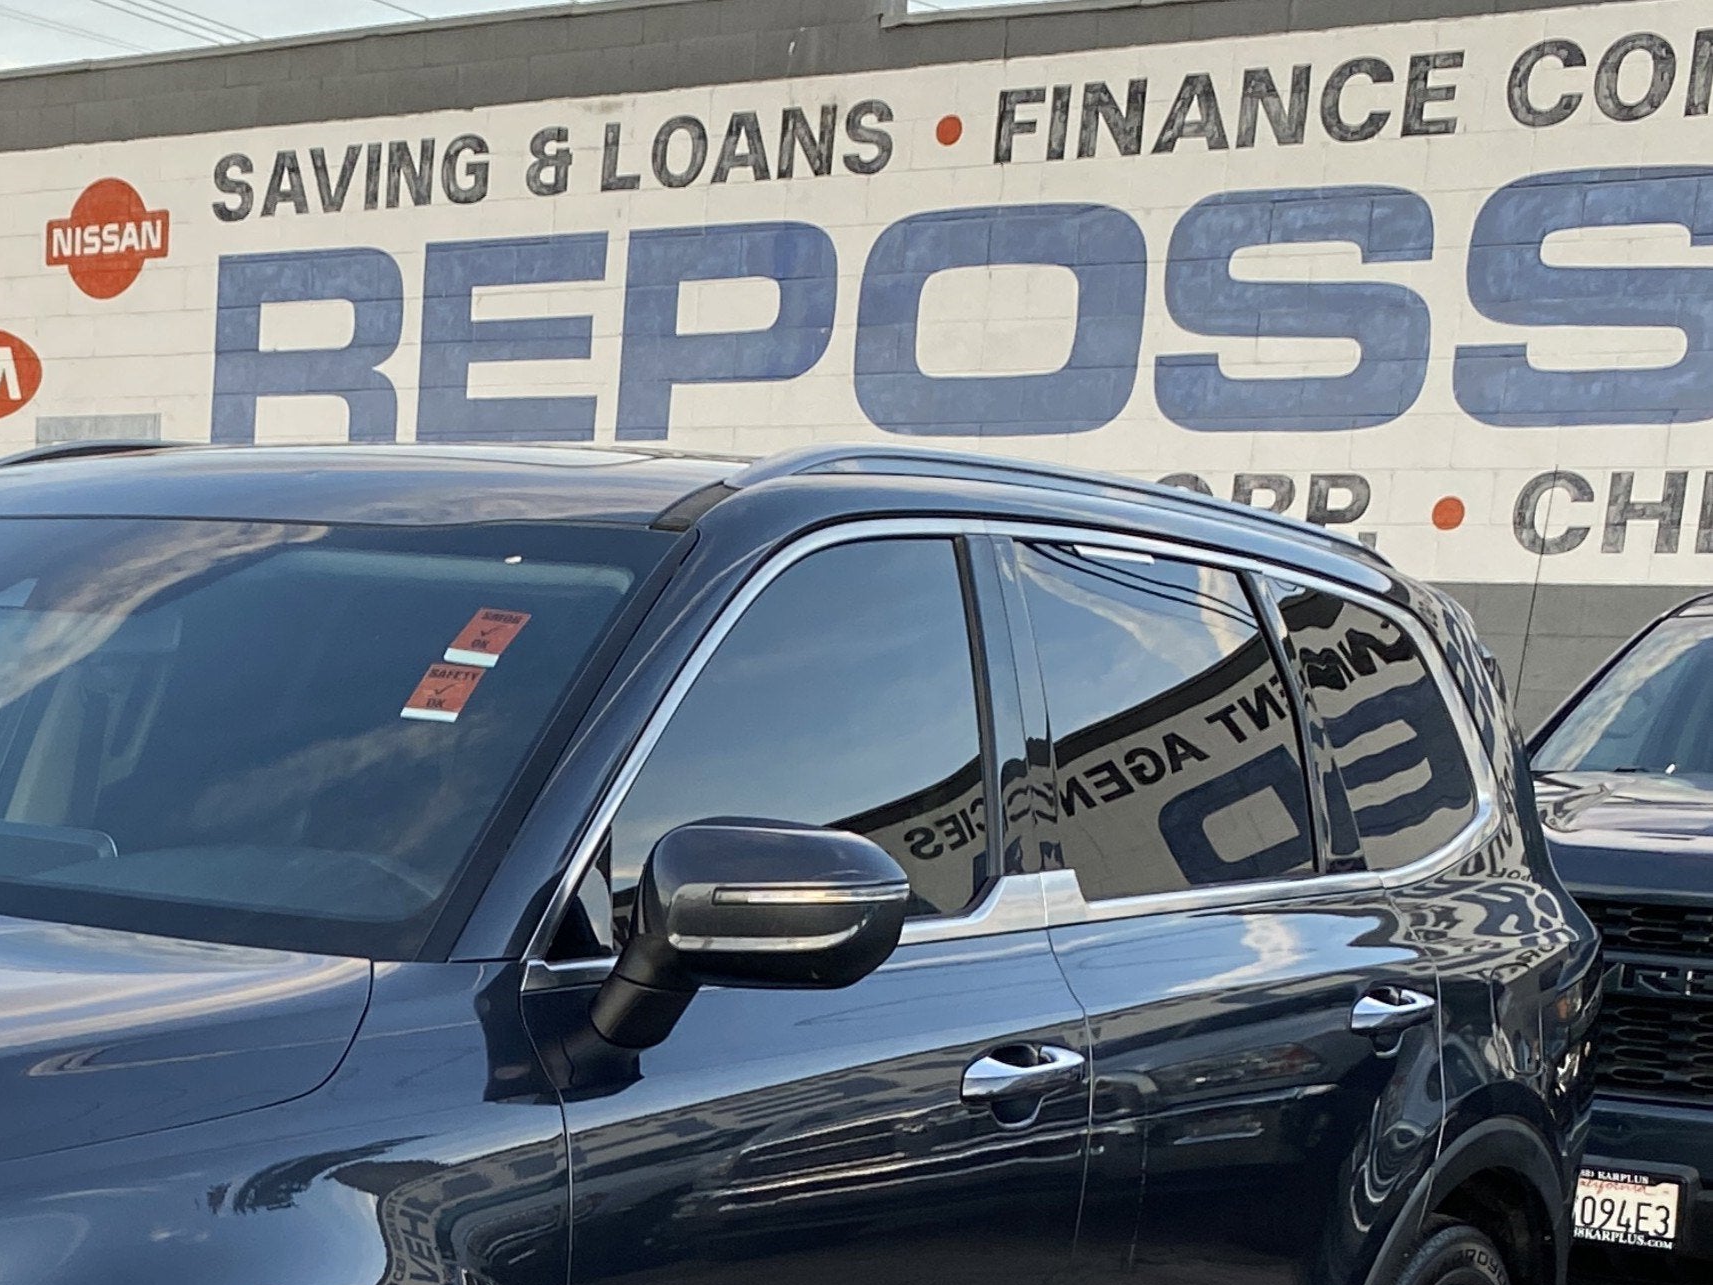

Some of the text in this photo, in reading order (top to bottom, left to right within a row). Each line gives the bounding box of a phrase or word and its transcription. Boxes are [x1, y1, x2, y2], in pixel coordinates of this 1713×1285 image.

[211, 133, 490, 223] SAVING
[526, 125, 573, 197] &
[600, 99, 895, 193] LOANS
[992, 50, 1466, 165] FINANCE
[51, 219, 163, 258] NISSAN
[210, 163, 1713, 444] REPOSS
[1598, 1171, 1649, 1185] KARPLUS
[1578, 1195, 1671, 1237] 094E3
